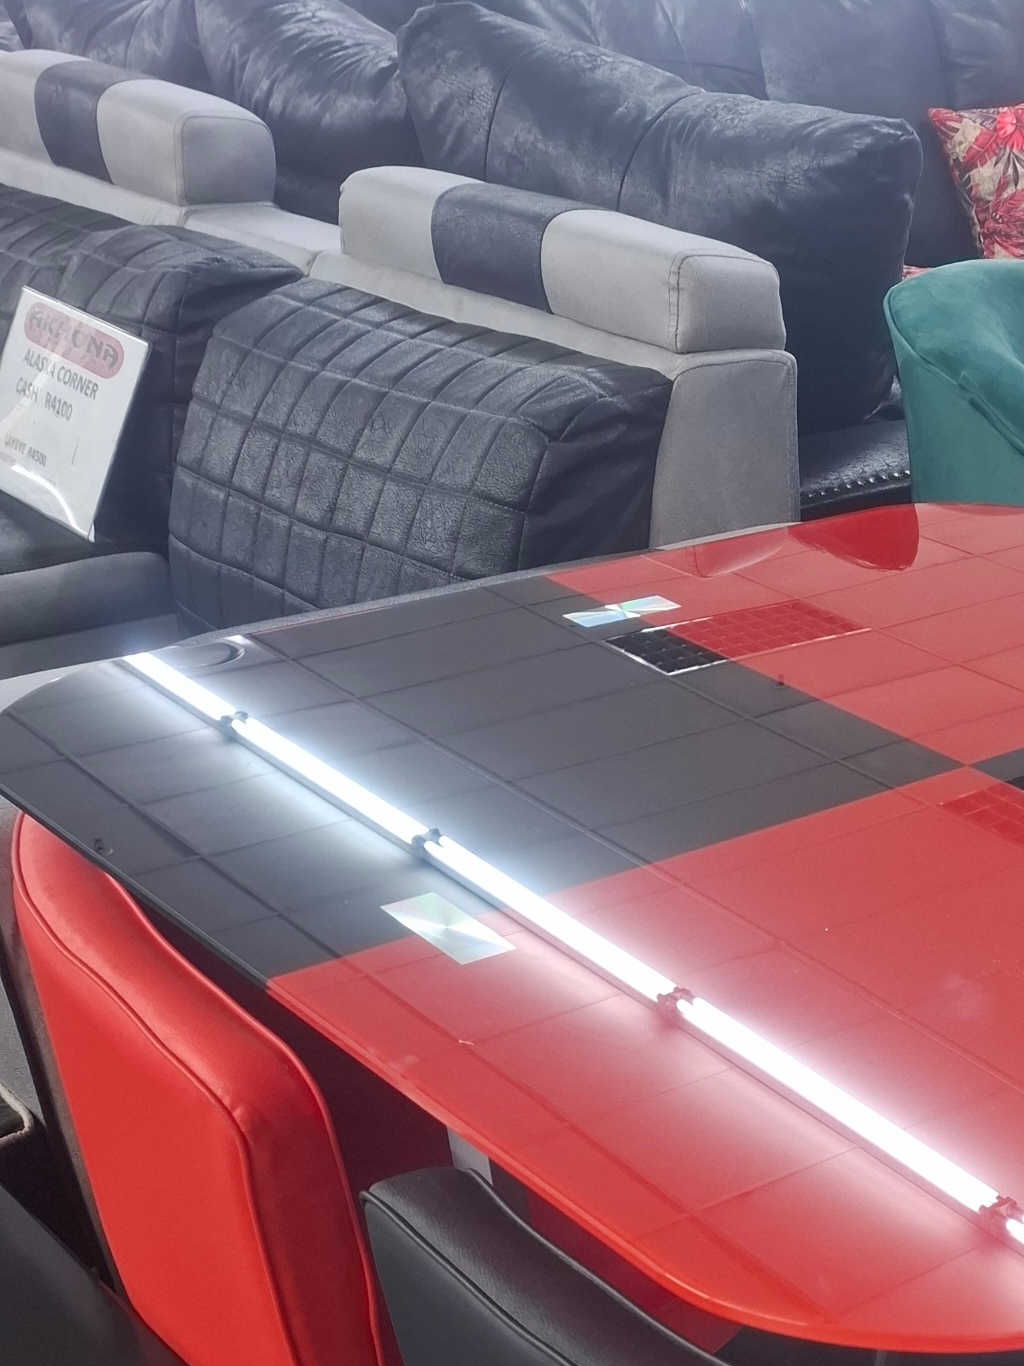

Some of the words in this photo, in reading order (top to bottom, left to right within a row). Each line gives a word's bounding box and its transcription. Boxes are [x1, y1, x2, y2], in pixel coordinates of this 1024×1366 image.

[23, 348, 56, 379] ALASKA
[56, 365, 99, 401] CORNER
[16, 377, 39, 403] CASH
[44, 391, 73, 421] R4100
